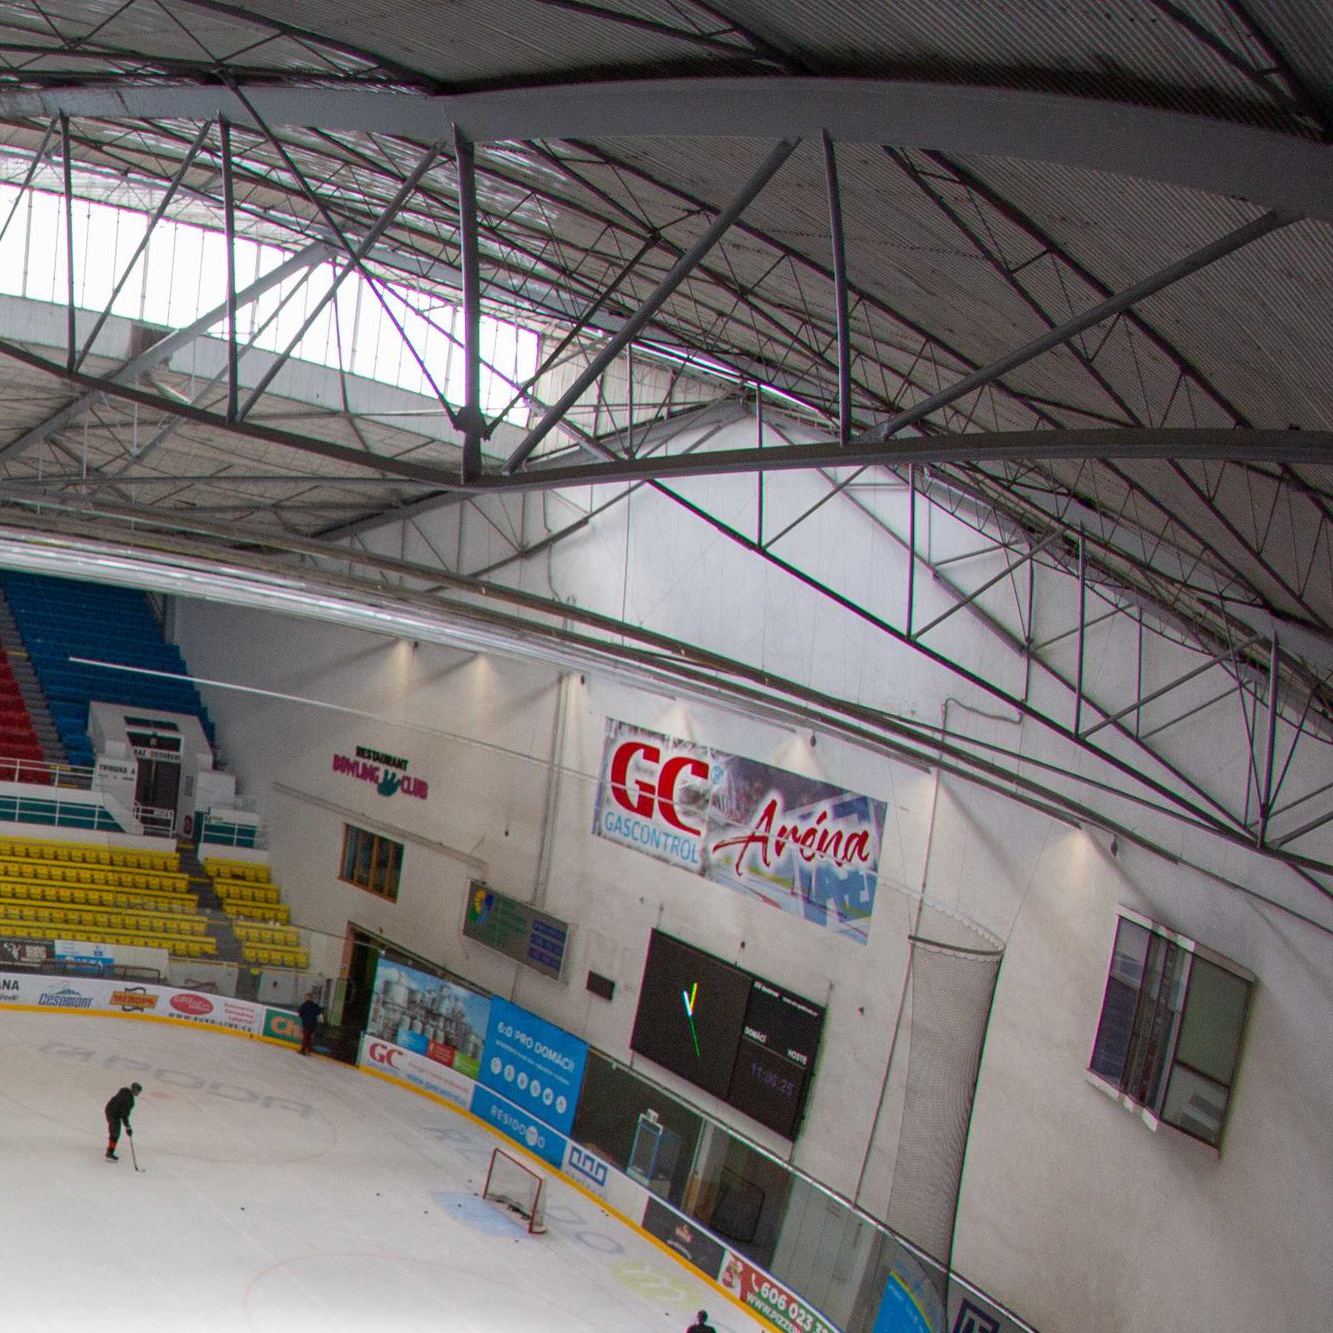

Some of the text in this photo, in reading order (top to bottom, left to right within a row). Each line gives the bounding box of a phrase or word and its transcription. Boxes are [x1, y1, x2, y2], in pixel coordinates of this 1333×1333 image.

[332, 754, 429, 800] BOWLING CLUB
[611, 742, 710, 837] GC
[605, 811, 699, 864] GASCONTROL
[712, 799, 870, 877] Aréna
[368, 1042, 404, 1070] GC
[497, 1021, 514, 1038] 6:0
[514, 1029, 534, 1050] PRO
[760, 1282, 788, 1312] 606
[788, 1302, 814, 1331] 023
